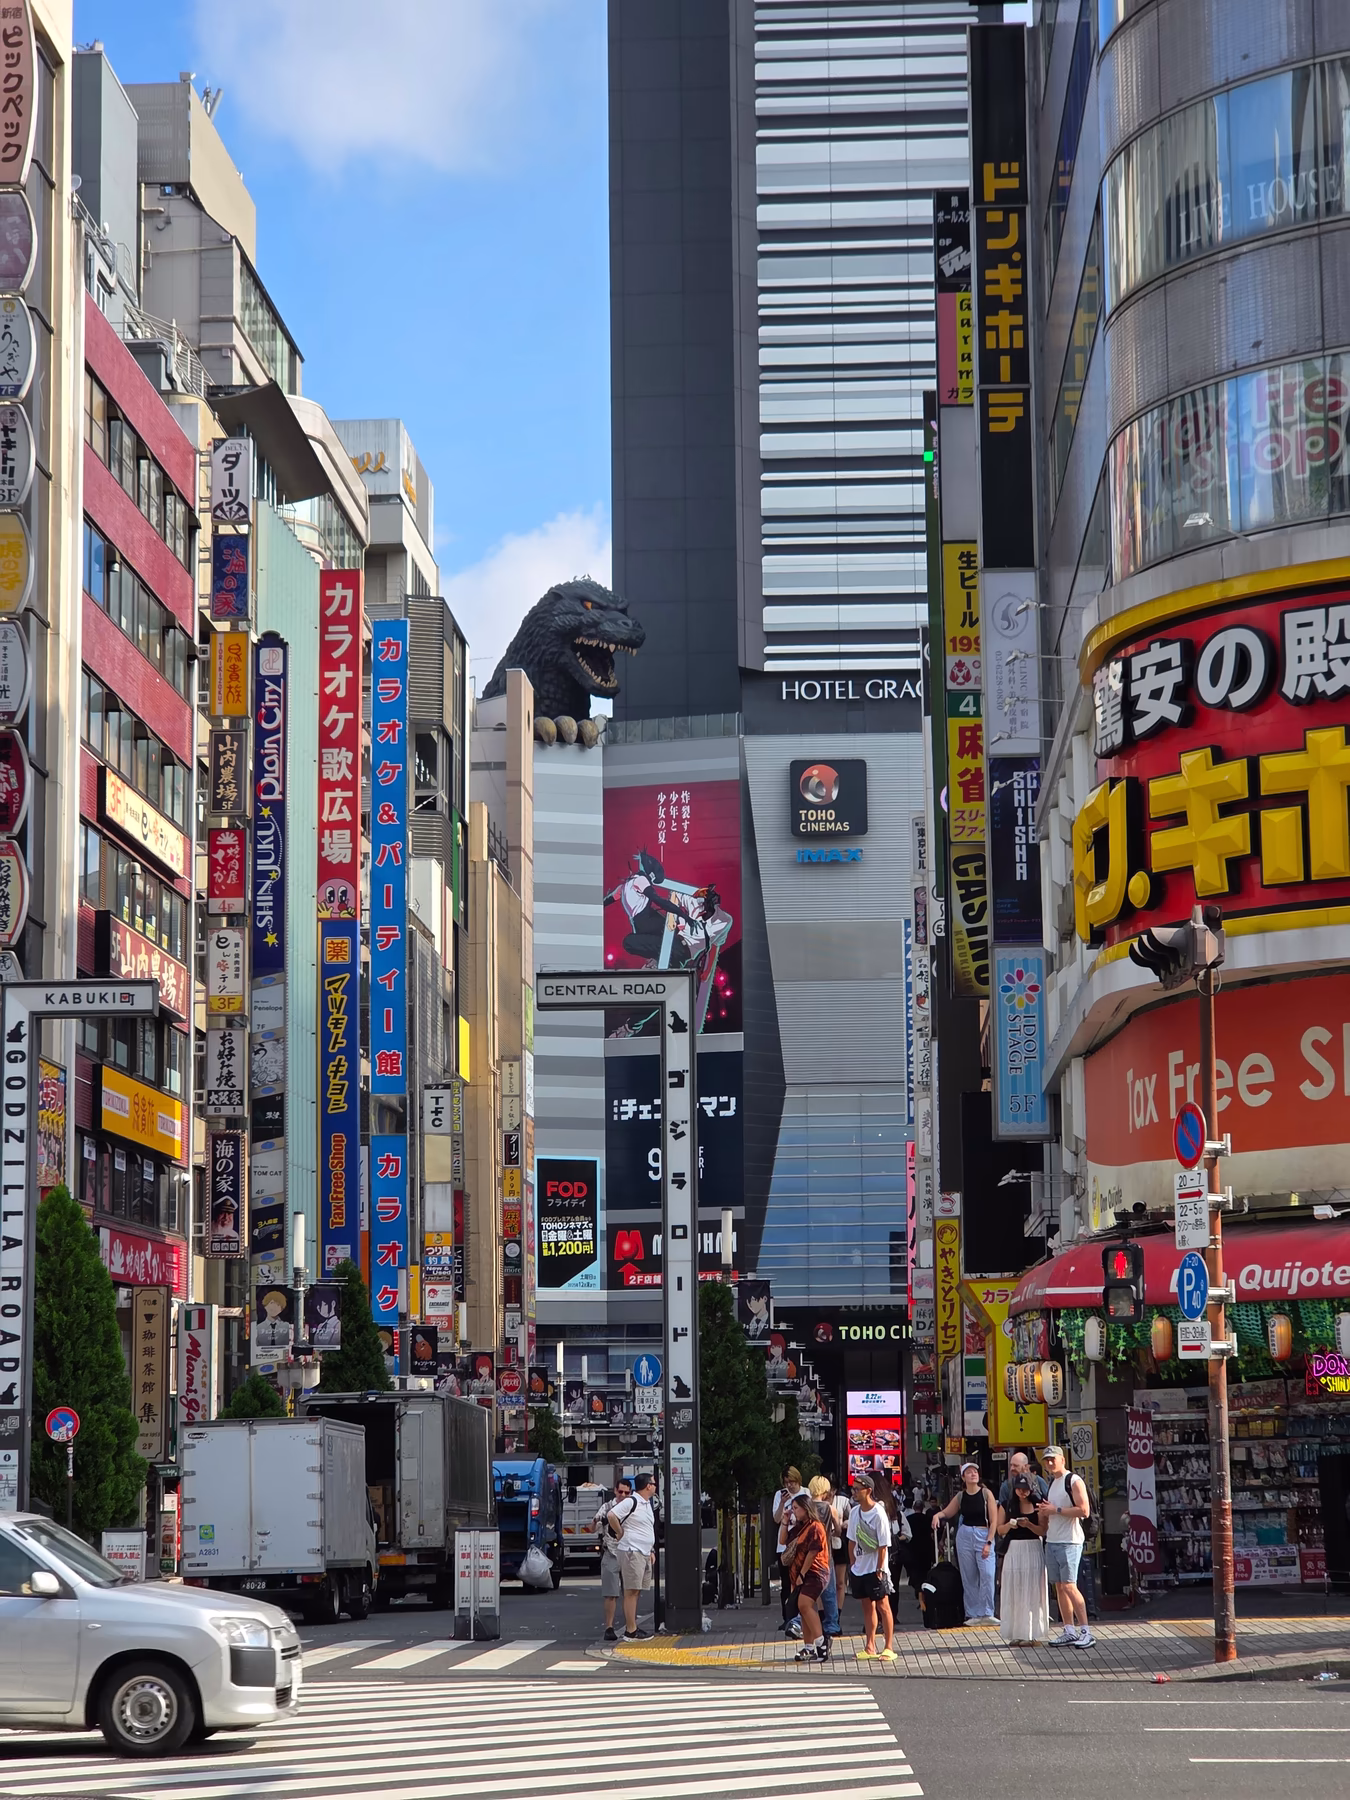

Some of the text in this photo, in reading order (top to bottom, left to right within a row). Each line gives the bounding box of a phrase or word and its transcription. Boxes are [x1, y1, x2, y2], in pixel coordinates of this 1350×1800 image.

[1, 7, 23, 19] 新宿
[1, 386, 16, 395] 7F
[947, 387, 974, 400] ガラ
[221, 452, 242, 507] ダーツ
[782, 681, 860, 700] HOTEL
[321, 582, 354, 864] カラオケ歌広場
[217, 735, 239, 801] 山内農場
[221, 801, 233, 810] 5F
[669, 791, 679, 831] 少年と
[681, 790, 691, 844] 炸裂する
[799, 809, 836, 821] TOHO
[799, 821, 850, 832] CINEMAS
[375, 636, 403, 1077] カラオケ&パーティー館
[256, 820, 282, 929] SHINJUKU
[217, 901, 235, 913] 4F
[327, 940, 350, 962] 薬
[544, 983, 667, 996] CENTRAL ROAD
[217, 997, 236, 1010] 3F
[254, 1004, 283, 1012] Penelope
[1007, 1013, 1022, 1076] STAGE
[1023, 1013, 1037, 1065] IDOL
[215, 1031, 237, 1089] お好み焼
[208, 1090, 242, 1105] 大阪家
[1126, 1067, 1159, 1135] Tax
[509, 1134, 518, 1160] ダーツ
[215, 1139, 235, 1193] 海の家
[330, 1133, 347, 1229] Tax Free Shop
[546, 1181, 588, 1198] FOD
[0, 1049, 28, 1373] GODZILLA ROAD
[546, 1199, 587, 1208] フライデイ
[667, 1068, 690, 1344] ゴジラロード
[376, 1153, 403, 1312] カラオケ
[839, 1325, 886, 1341] TOHO
[185, 1333, 202, 1396] Miami
[1127, 1419, 1153, 1436] HALA
[198, 1548, 220, 1557] A2831
